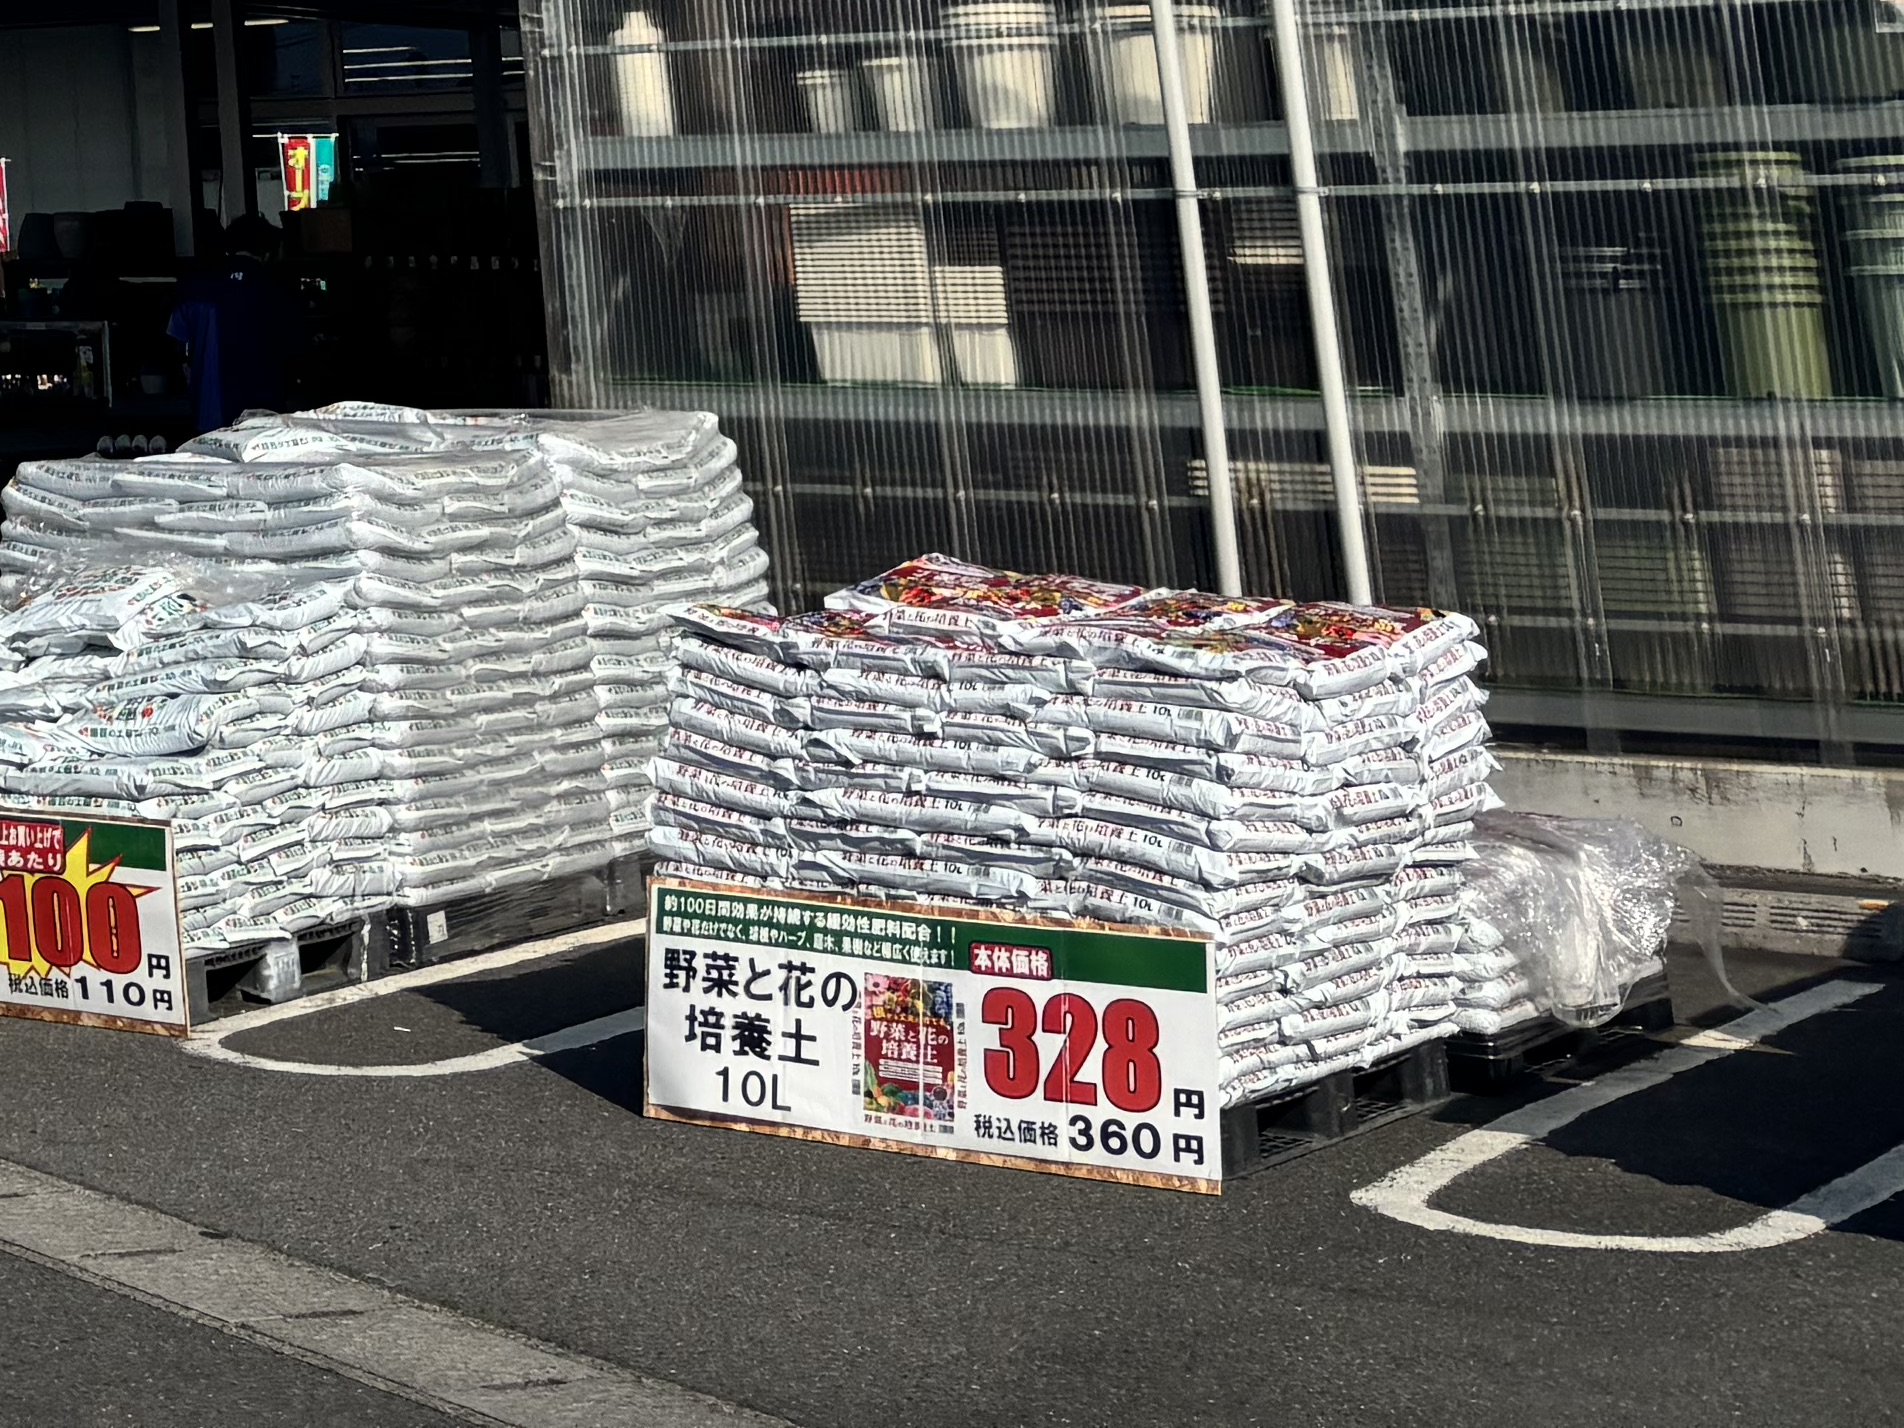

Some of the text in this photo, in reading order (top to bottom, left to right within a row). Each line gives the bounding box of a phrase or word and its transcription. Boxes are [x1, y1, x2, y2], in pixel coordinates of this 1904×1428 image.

[146, 952, 173, 980] 円
[973, 947, 1051, 978] 本体価格
[8, 971, 69, 999] 税込価格
[663, 947, 857, 1013] 野菜と花の
[683, 1003, 821, 1067] 培養土
[870, 1019, 949, 1046] 野菜と花の
[880, 1041, 938, 1064] 培養土
[980, 986, 1207, 1120] 328 円
[714, 1064, 793, 1113] 10L
[973, 1114, 1060, 1149] 税込価格
